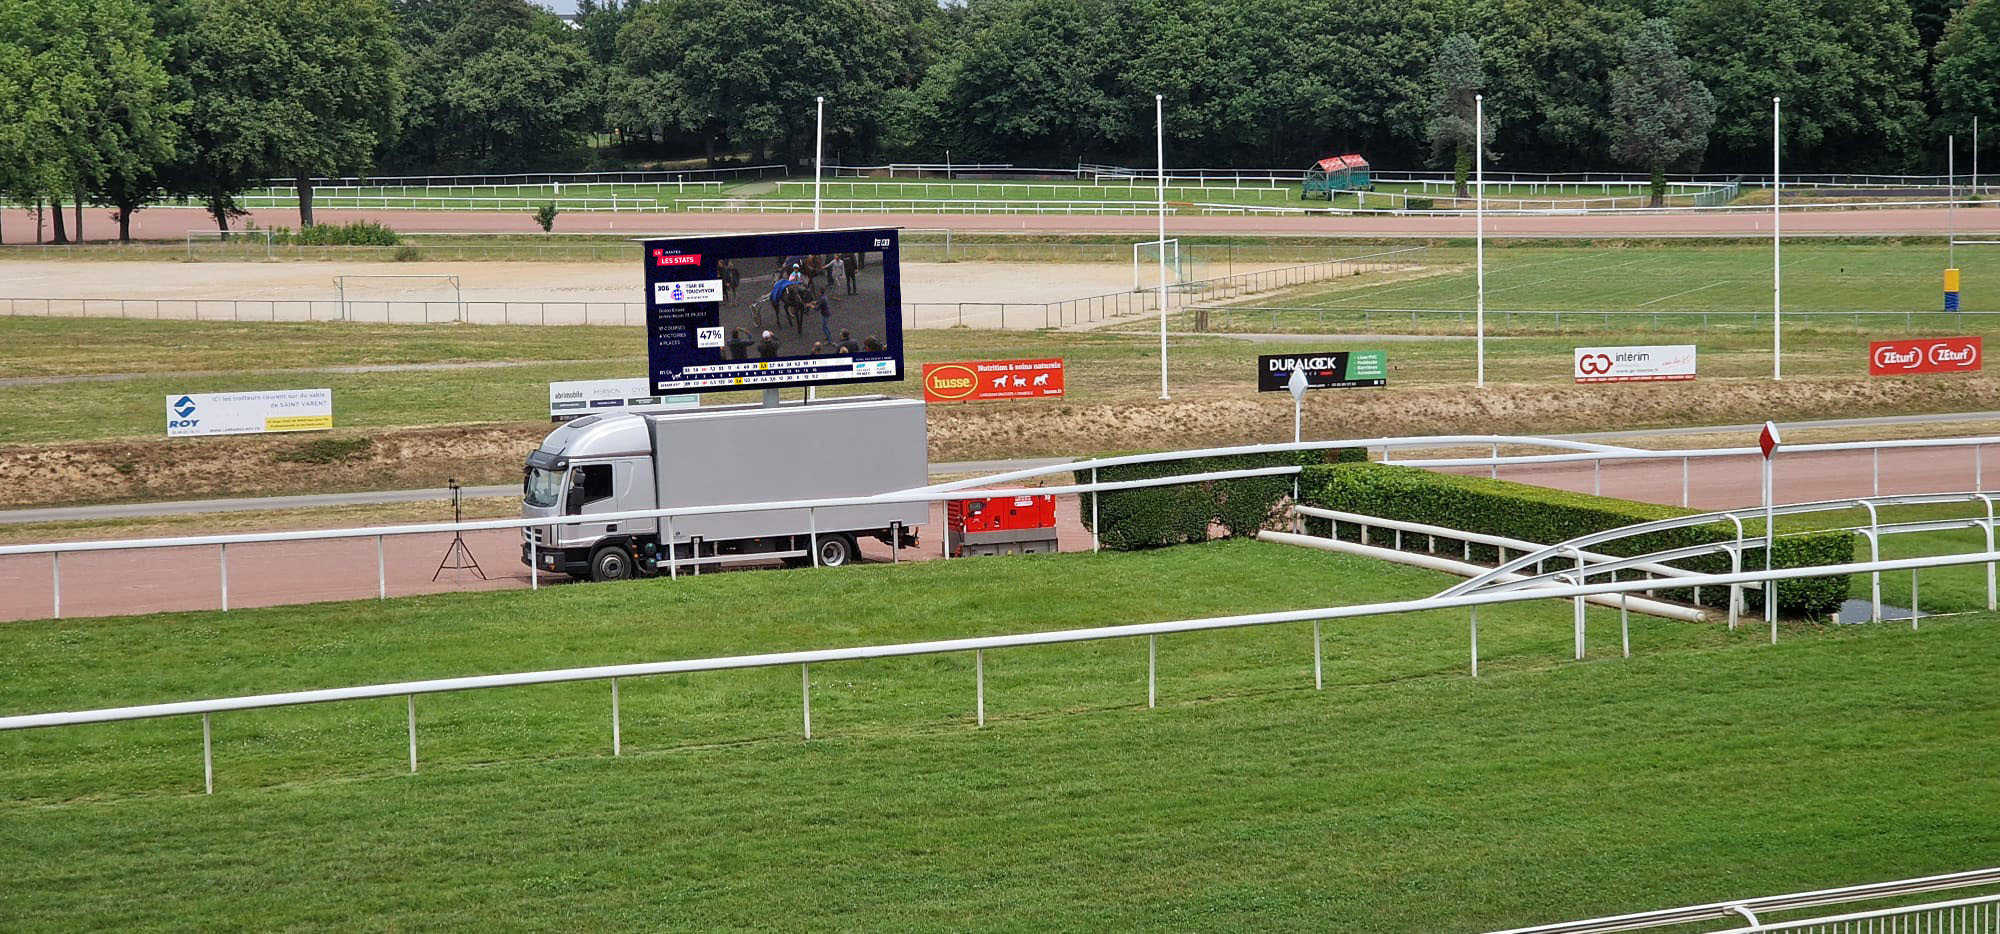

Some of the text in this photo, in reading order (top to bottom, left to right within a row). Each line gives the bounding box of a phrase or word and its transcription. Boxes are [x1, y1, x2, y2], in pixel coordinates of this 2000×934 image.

[700, 330, 721, 339] 47%
[1616, 352, 1649, 361] intérim
[1884, 351, 1916, 364] ZEturf
[1937, 348, 1970, 360] ZEturf
[1269, 357, 1336, 371] DURALOCK
[934, 376, 970, 388] husse
[555, 391, 583, 399] abrimobile
[169, 420, 200, 428] ROY
